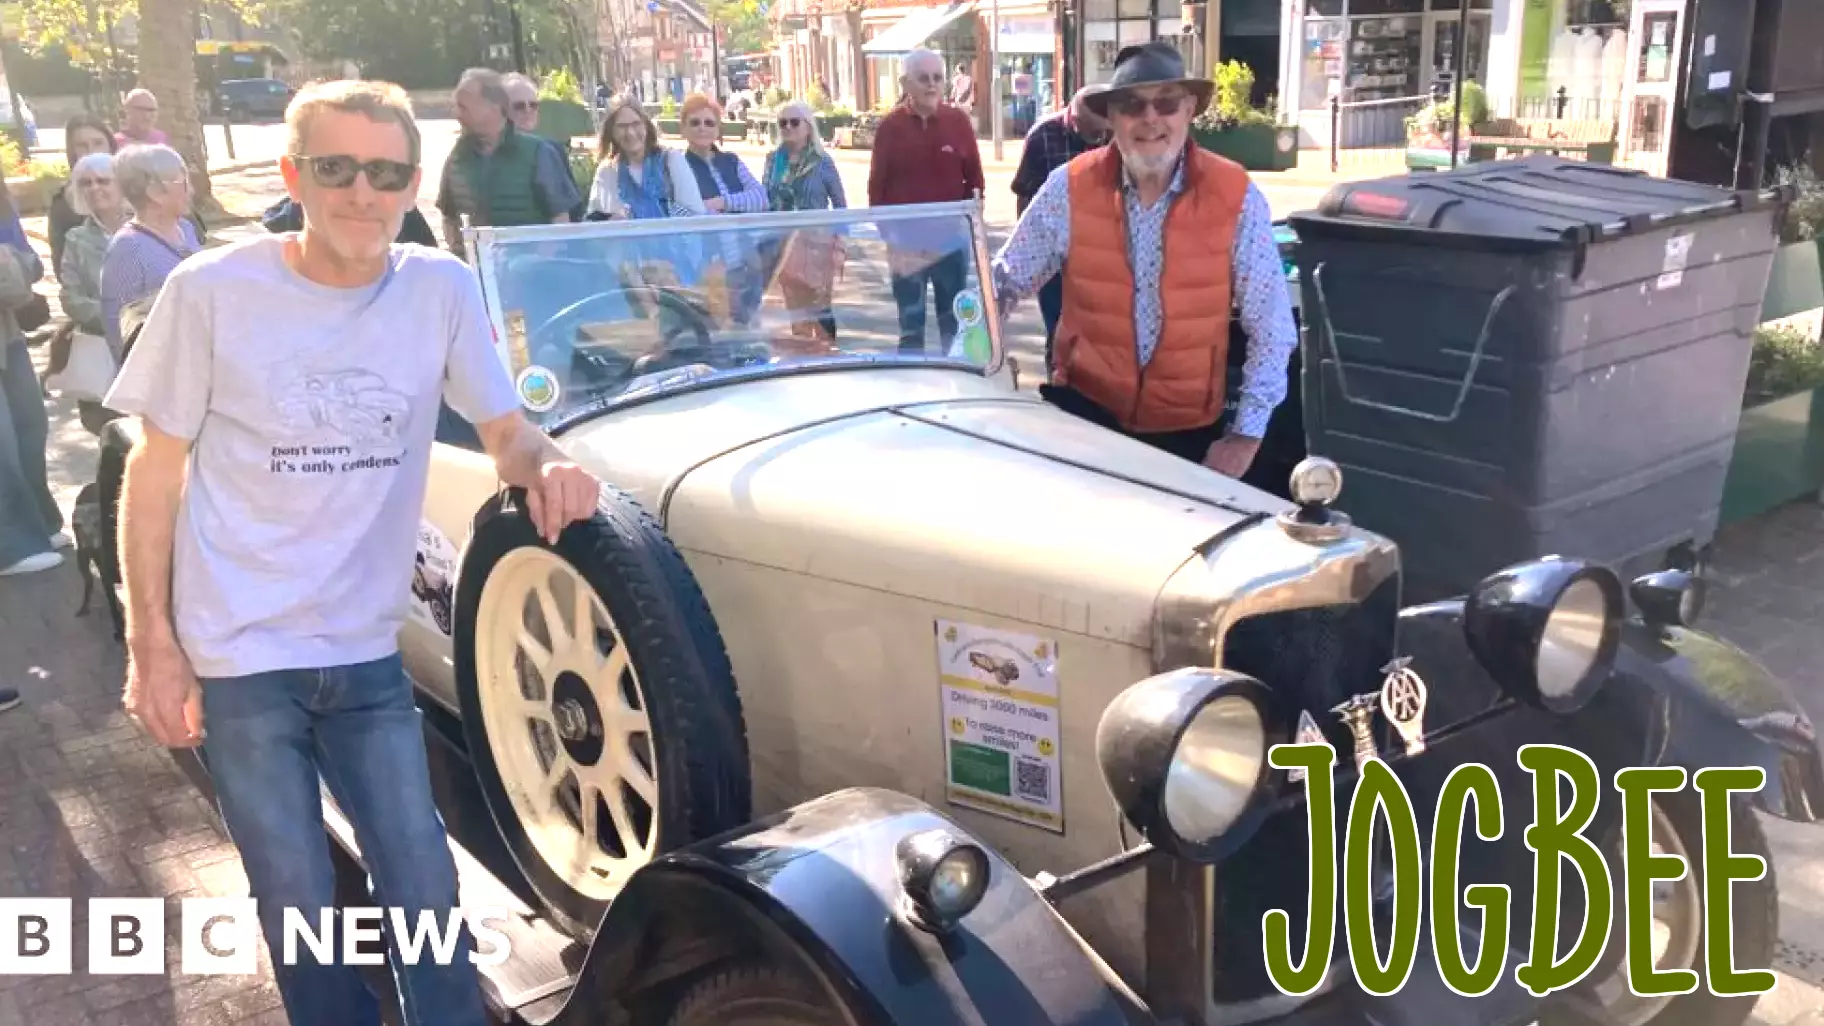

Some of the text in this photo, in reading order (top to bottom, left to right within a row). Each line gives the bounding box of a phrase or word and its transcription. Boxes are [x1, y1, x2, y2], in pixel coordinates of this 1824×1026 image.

[311, 445, 351, 457] worry
[270, 453, 402, 475] it's only condens
[950, 690, 988, 711] Driving
[1018, 707, 1049, 722] miles
[1006, 728, 1037, 742] more
